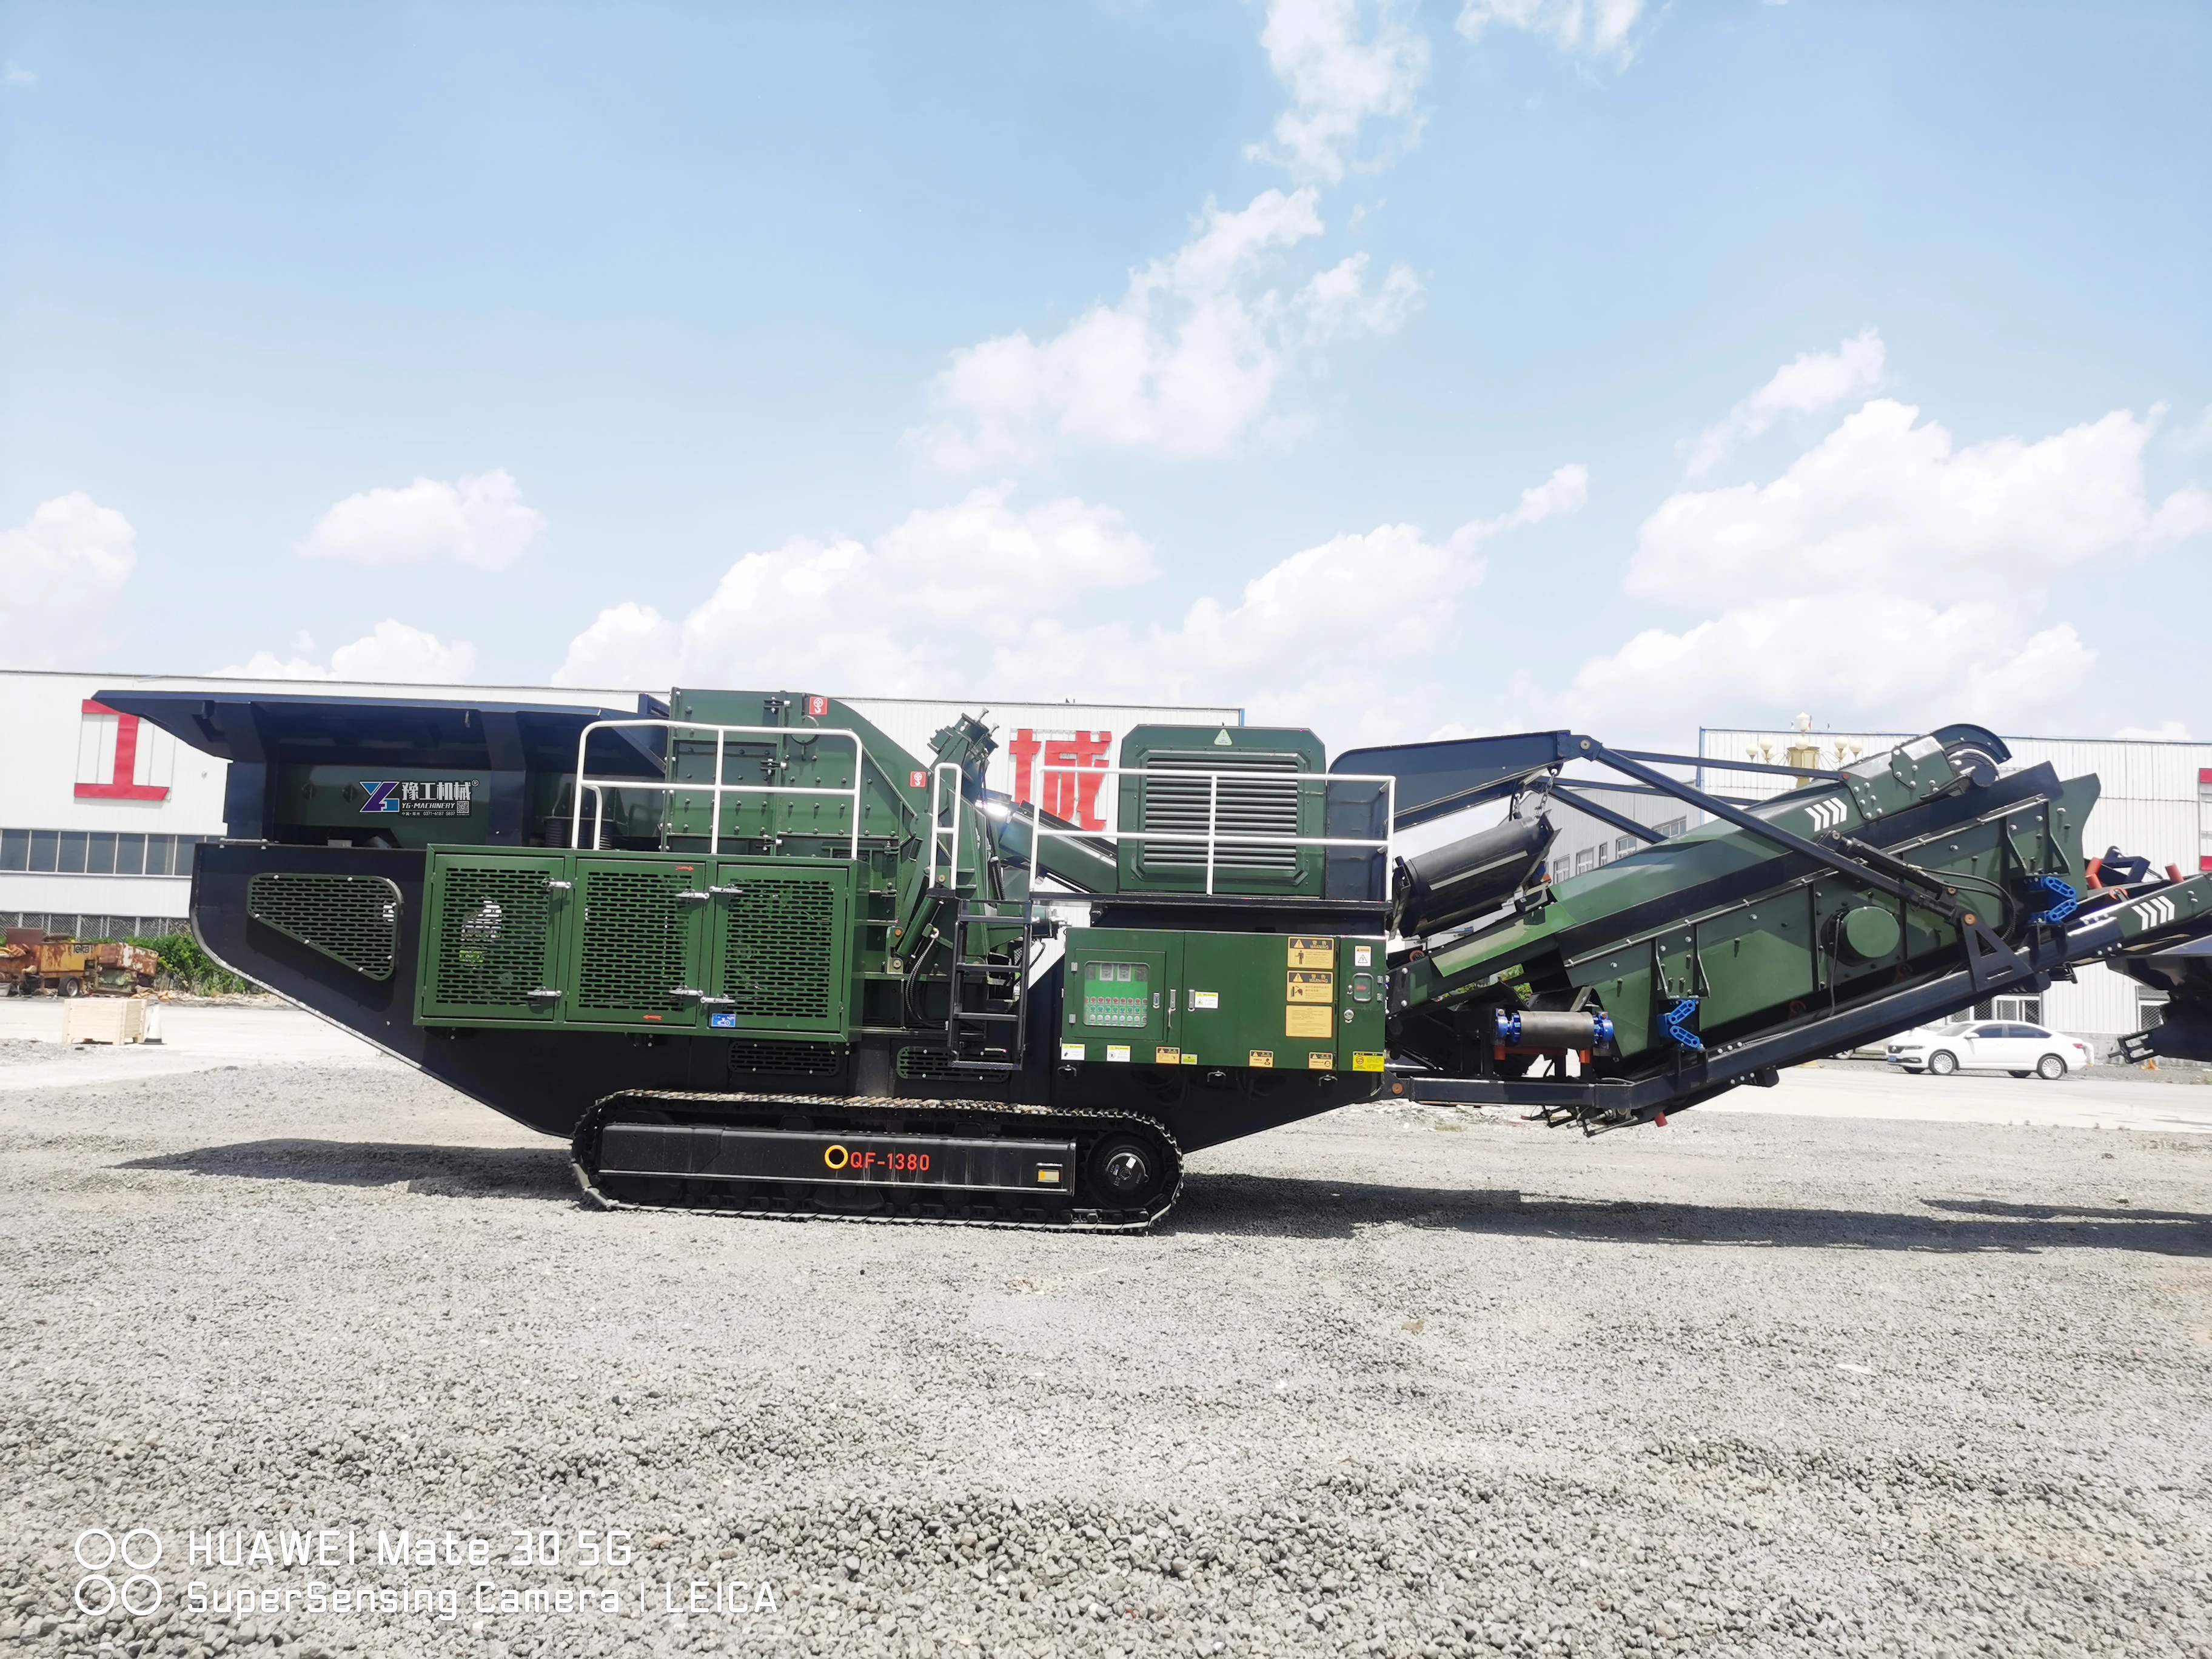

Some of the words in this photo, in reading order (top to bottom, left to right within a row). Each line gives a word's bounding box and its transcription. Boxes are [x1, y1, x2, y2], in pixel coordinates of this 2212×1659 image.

[401, 782, 471, 800] 豫工机械
[850, 1151, 930, 1171] QF-1380
